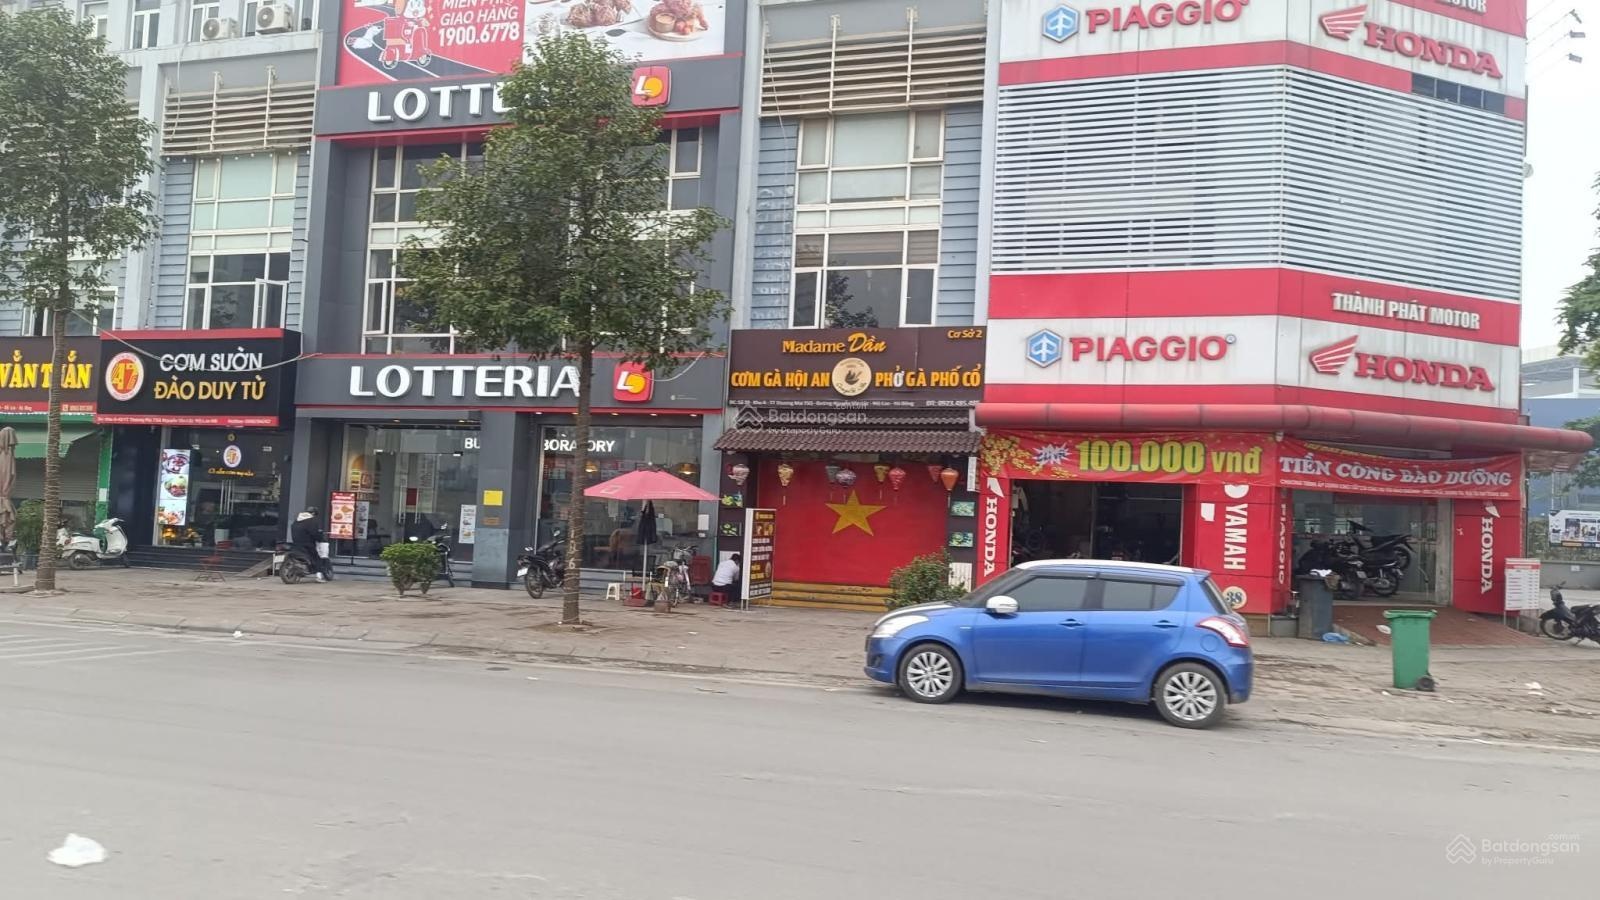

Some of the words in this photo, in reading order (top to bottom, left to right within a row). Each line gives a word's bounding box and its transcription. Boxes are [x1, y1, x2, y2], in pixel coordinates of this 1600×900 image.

[441, 11, 474, 26] GIAO
[477, 6, 519, 23] HÀNG
[1086, 0, 1243, 34] PIAGGIO
[439, 22, 520, 47] 1900.6778
[1364, 22, 1503, 79] HONDA
[1331, 291, 1385, 316] THÀNH
[1387, 299, 1427, 322] PHÁT
[1428, 307, 1480, 330] MOTOR
[782, 339, 846, 353] Madame
[848, 332, 887, 353] Dần
[976, 330, 983, 338] 2
[160, 354, 206, 371] CƠM
[210, 346, 263, 371] SƯỜN
[1069, 335, 1228, 362] PIAGGIO
[112, 362, 139, 390] 47
[350, 365, 581, 398] LOTTERIA
[731, 371, 761, 387] CƠM
[763, 368, 782, 387] GÀ
[785, 370, 808, 391] HỘI
[810, 372, 830, 387] AN
[875, 365, 905, 388] PHỞ
[906, 367, 927, 387] GÀ
[930, 365, 962, 387] PHỐ
[962, 363, 982, 387] CỔ
[1354, 352, 1495, 392] HONDA
[154, 375, 195, 400] ĐÀO
[198, 381, 237, 400] DUY
[241, 375, 266, 400] TỪ
[1075, 440, 1206, 474] 100.000
[1211, 446, 1263, 474] vnđ
[1280, 452, 1332, 476] TIỀN
[1335, 462, 1398, 481] CÔNG
[1444, 468, 1512, 486] DƯỠNG
[984, 497, 998, 577] HONDA
[1223, 503, 1248, 570] YAMAH
[1481, 516, 1494, 594] HONDA
[1225, 591, 1243, 606] 38
